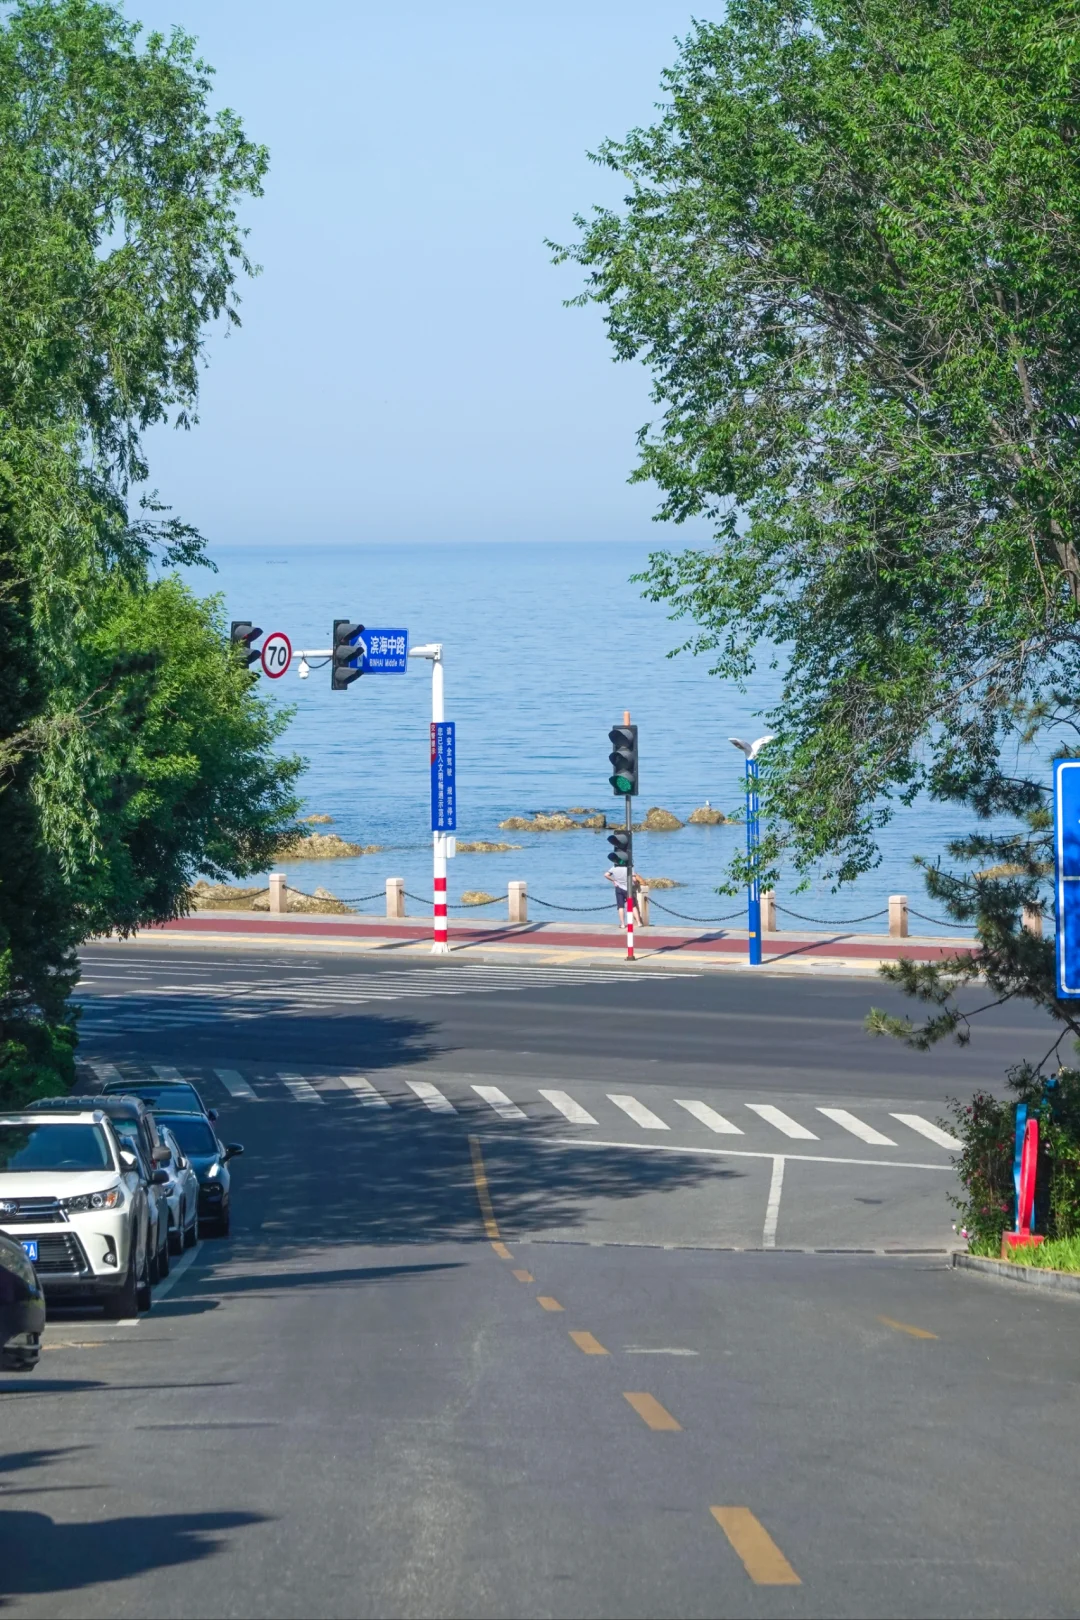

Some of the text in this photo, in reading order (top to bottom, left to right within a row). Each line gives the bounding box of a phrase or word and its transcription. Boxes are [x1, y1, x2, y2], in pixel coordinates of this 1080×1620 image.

[370, 635, 405, 655] 滨海中路
[268, 646, 286, 667] 70
